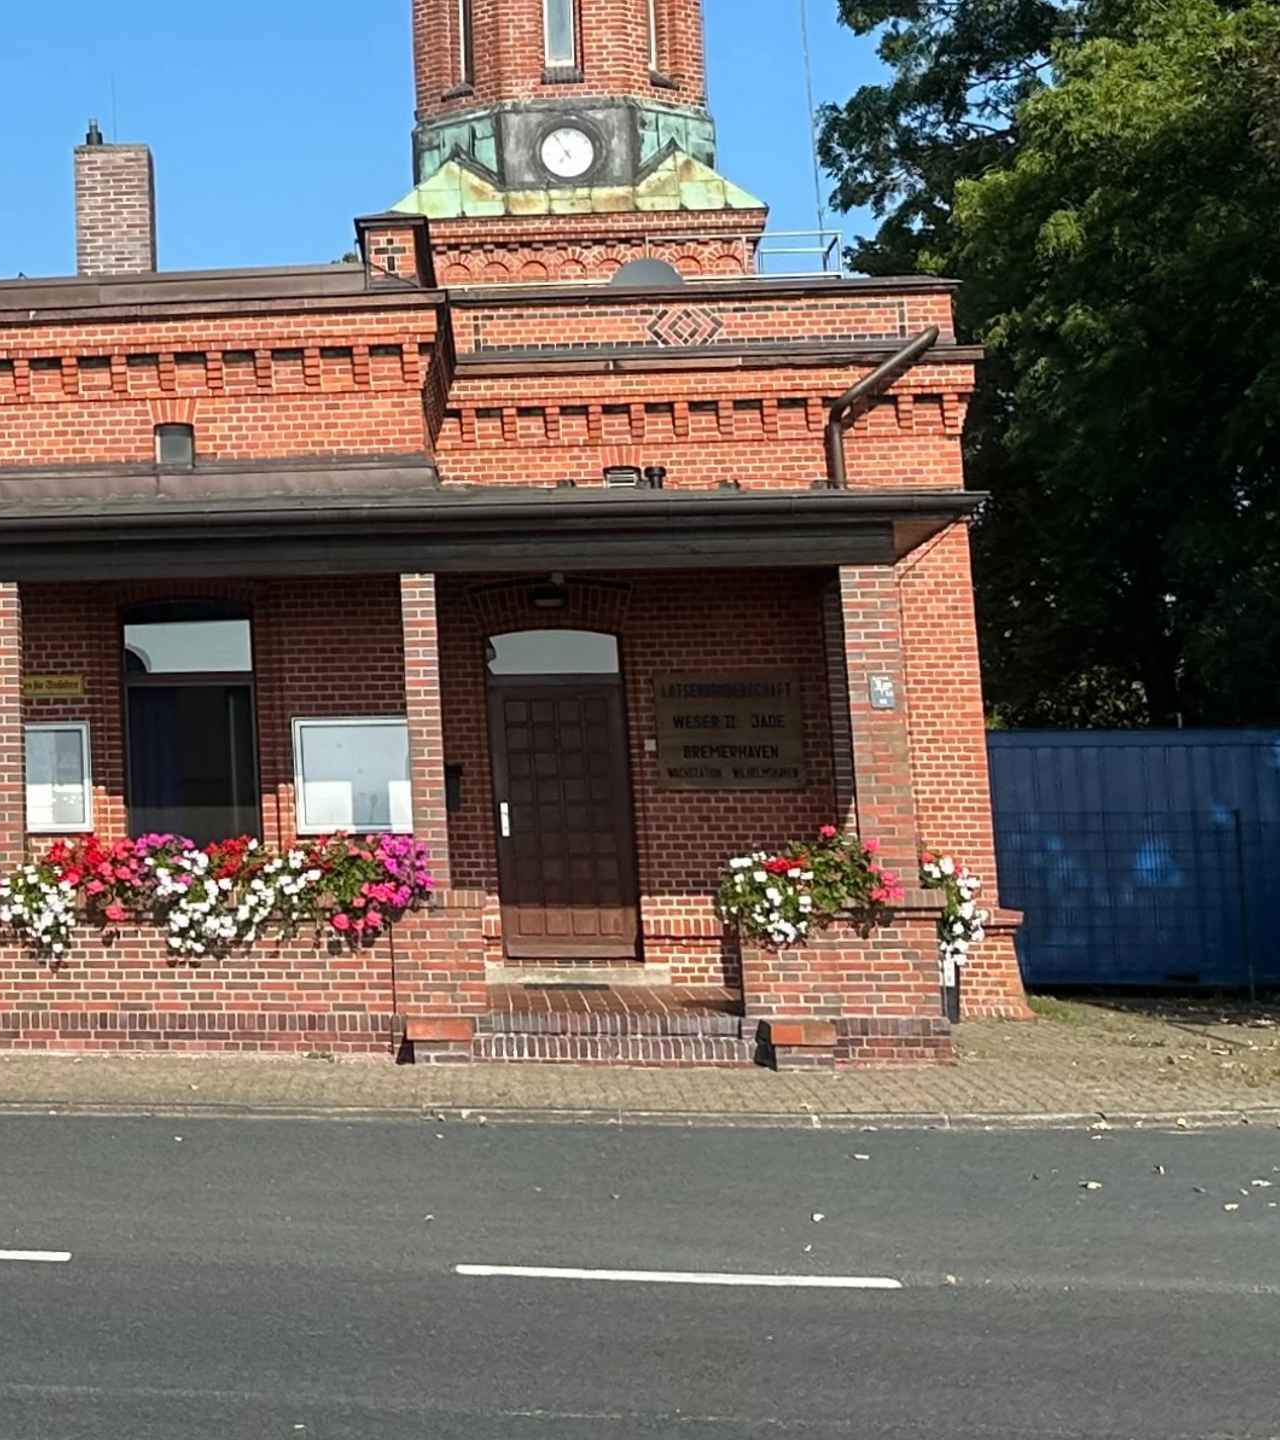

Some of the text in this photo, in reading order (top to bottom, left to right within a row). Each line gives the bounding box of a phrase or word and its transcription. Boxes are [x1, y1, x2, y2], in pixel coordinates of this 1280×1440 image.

[672, 714, 720, 729] WESER
[751, 713, 785, 729] JADE
[682, 744, 779, 759] BREMERHAVEN
